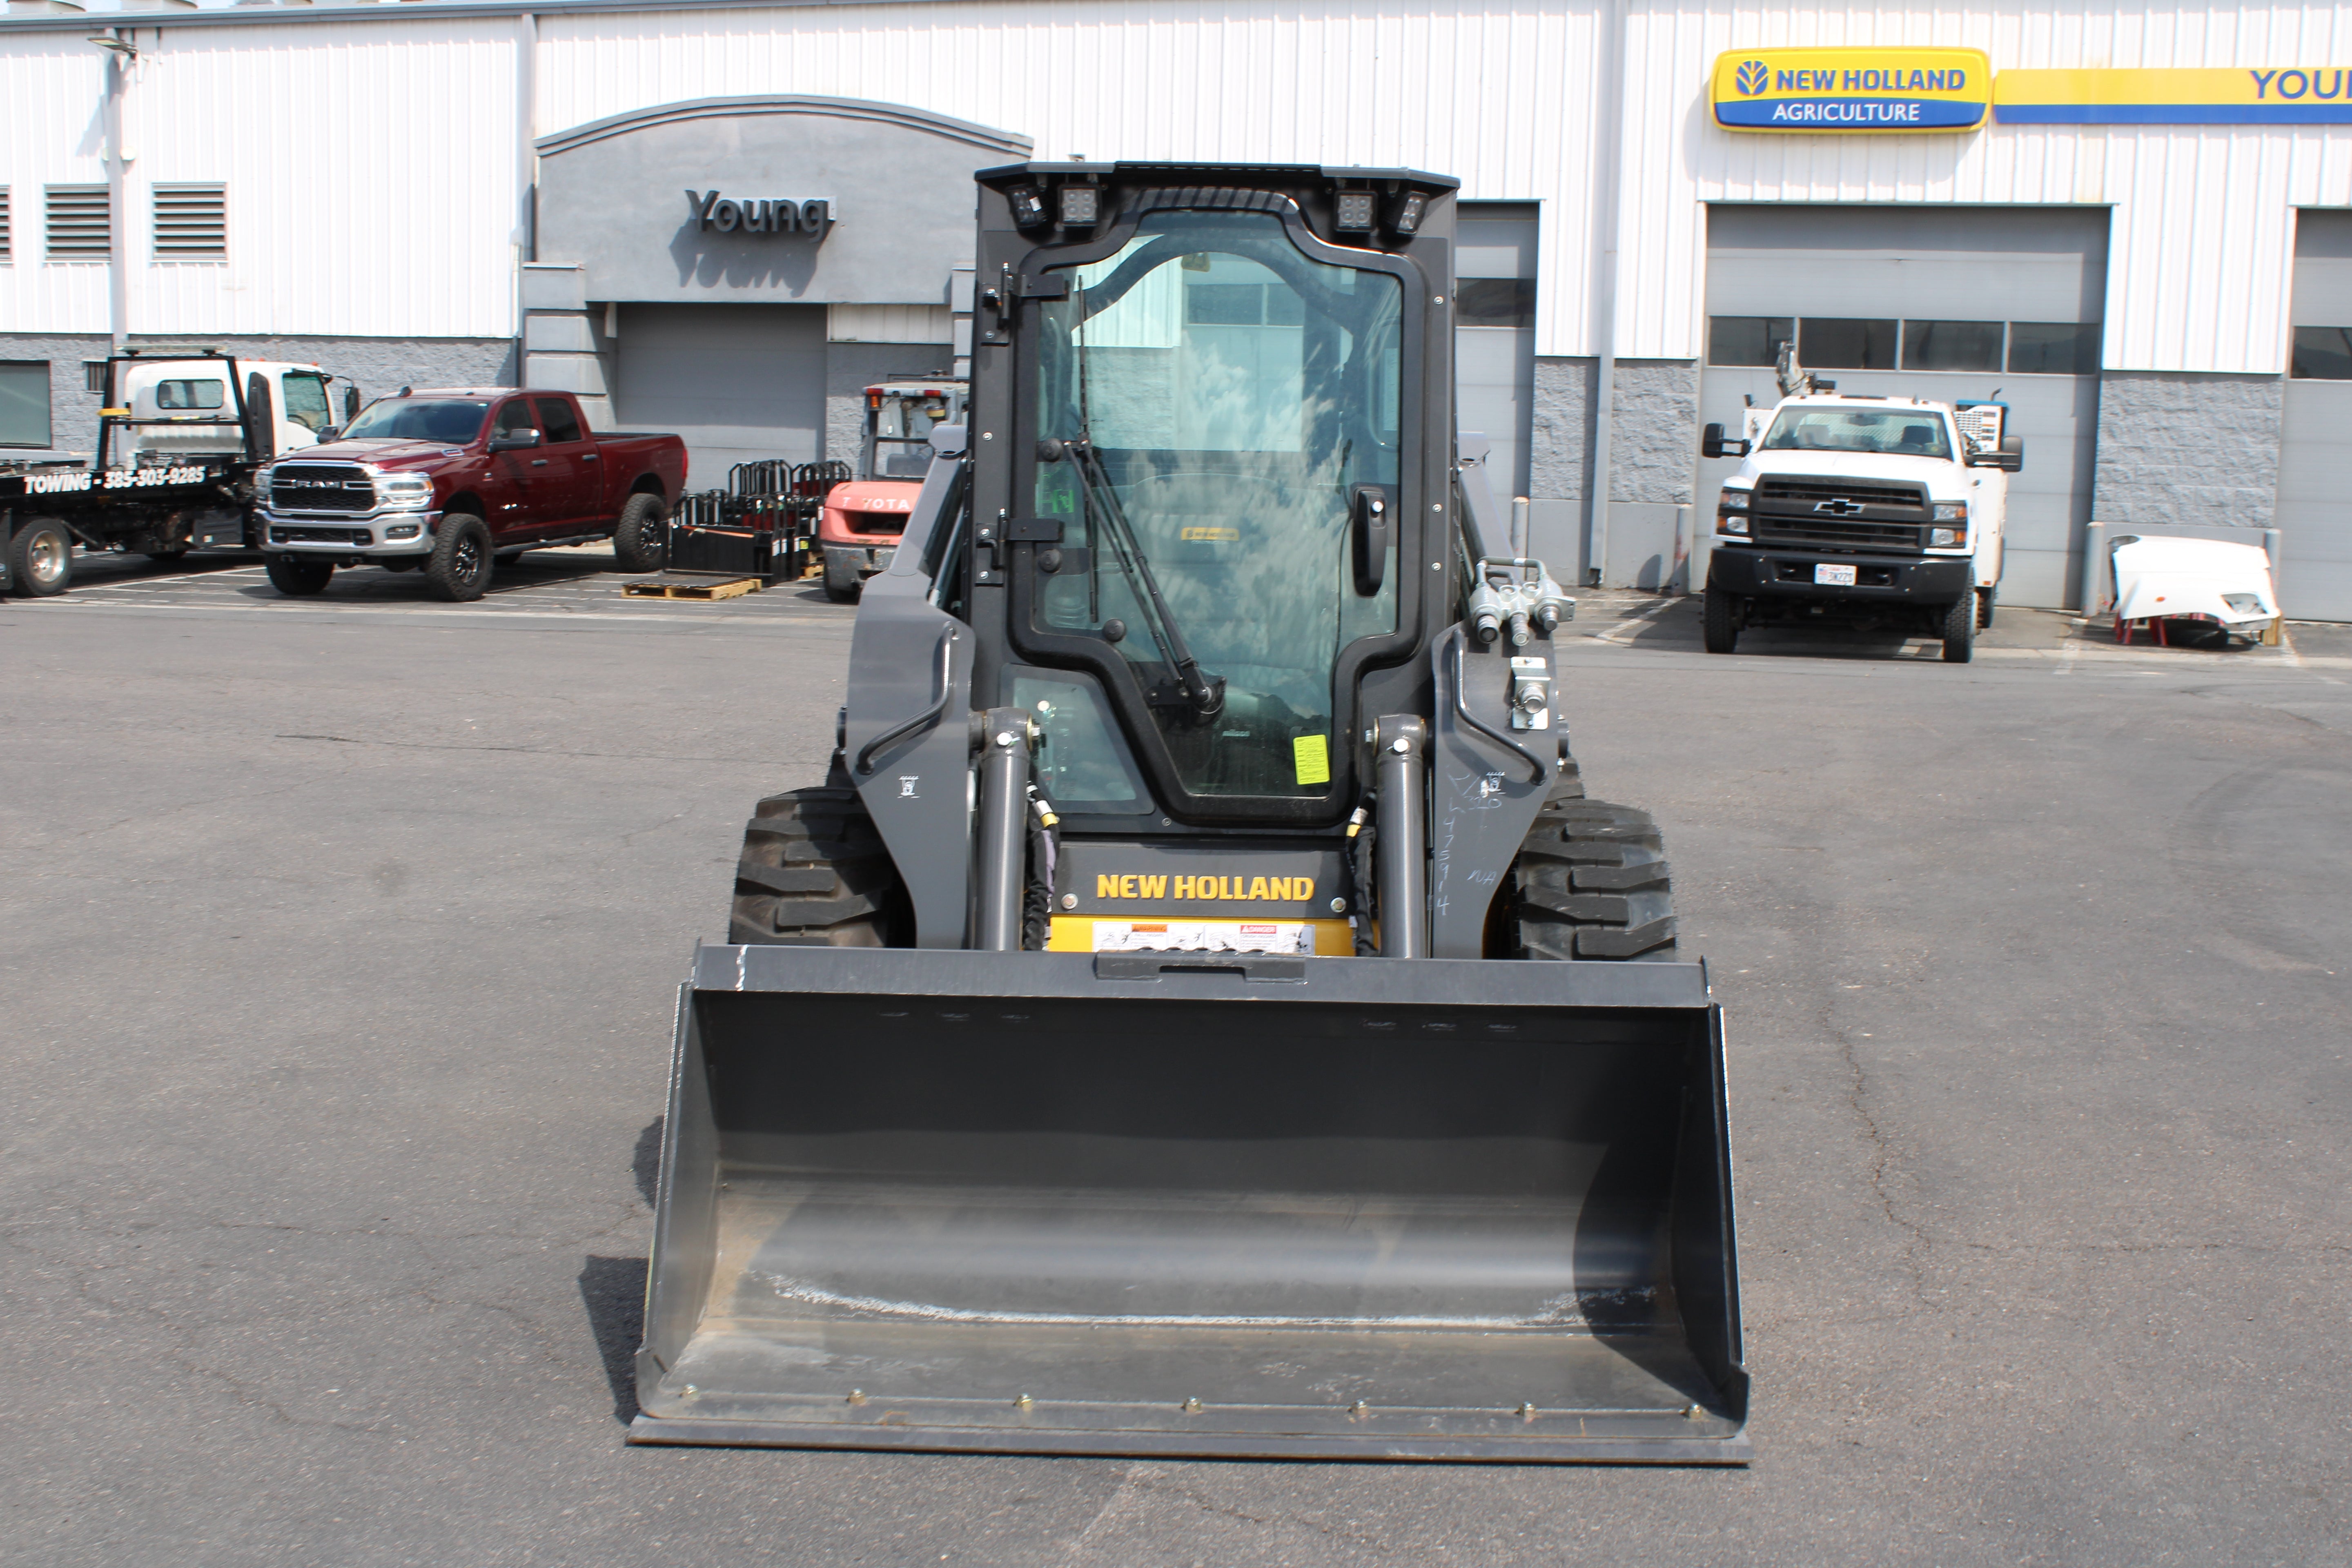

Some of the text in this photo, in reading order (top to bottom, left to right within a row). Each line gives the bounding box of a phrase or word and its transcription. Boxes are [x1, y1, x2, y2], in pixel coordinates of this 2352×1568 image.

[1776, 69, 1966, 91] NEW HOLLAND
[1772, 103, 1920, 121] AGRICULTURE
[684, 189, 829, 244] Young
[23, 472, 92, 494] TOWING
[103, 466, 206, 489] 385-303-9285
[1097, 874, 1315, 901] NEW HOLLAND
